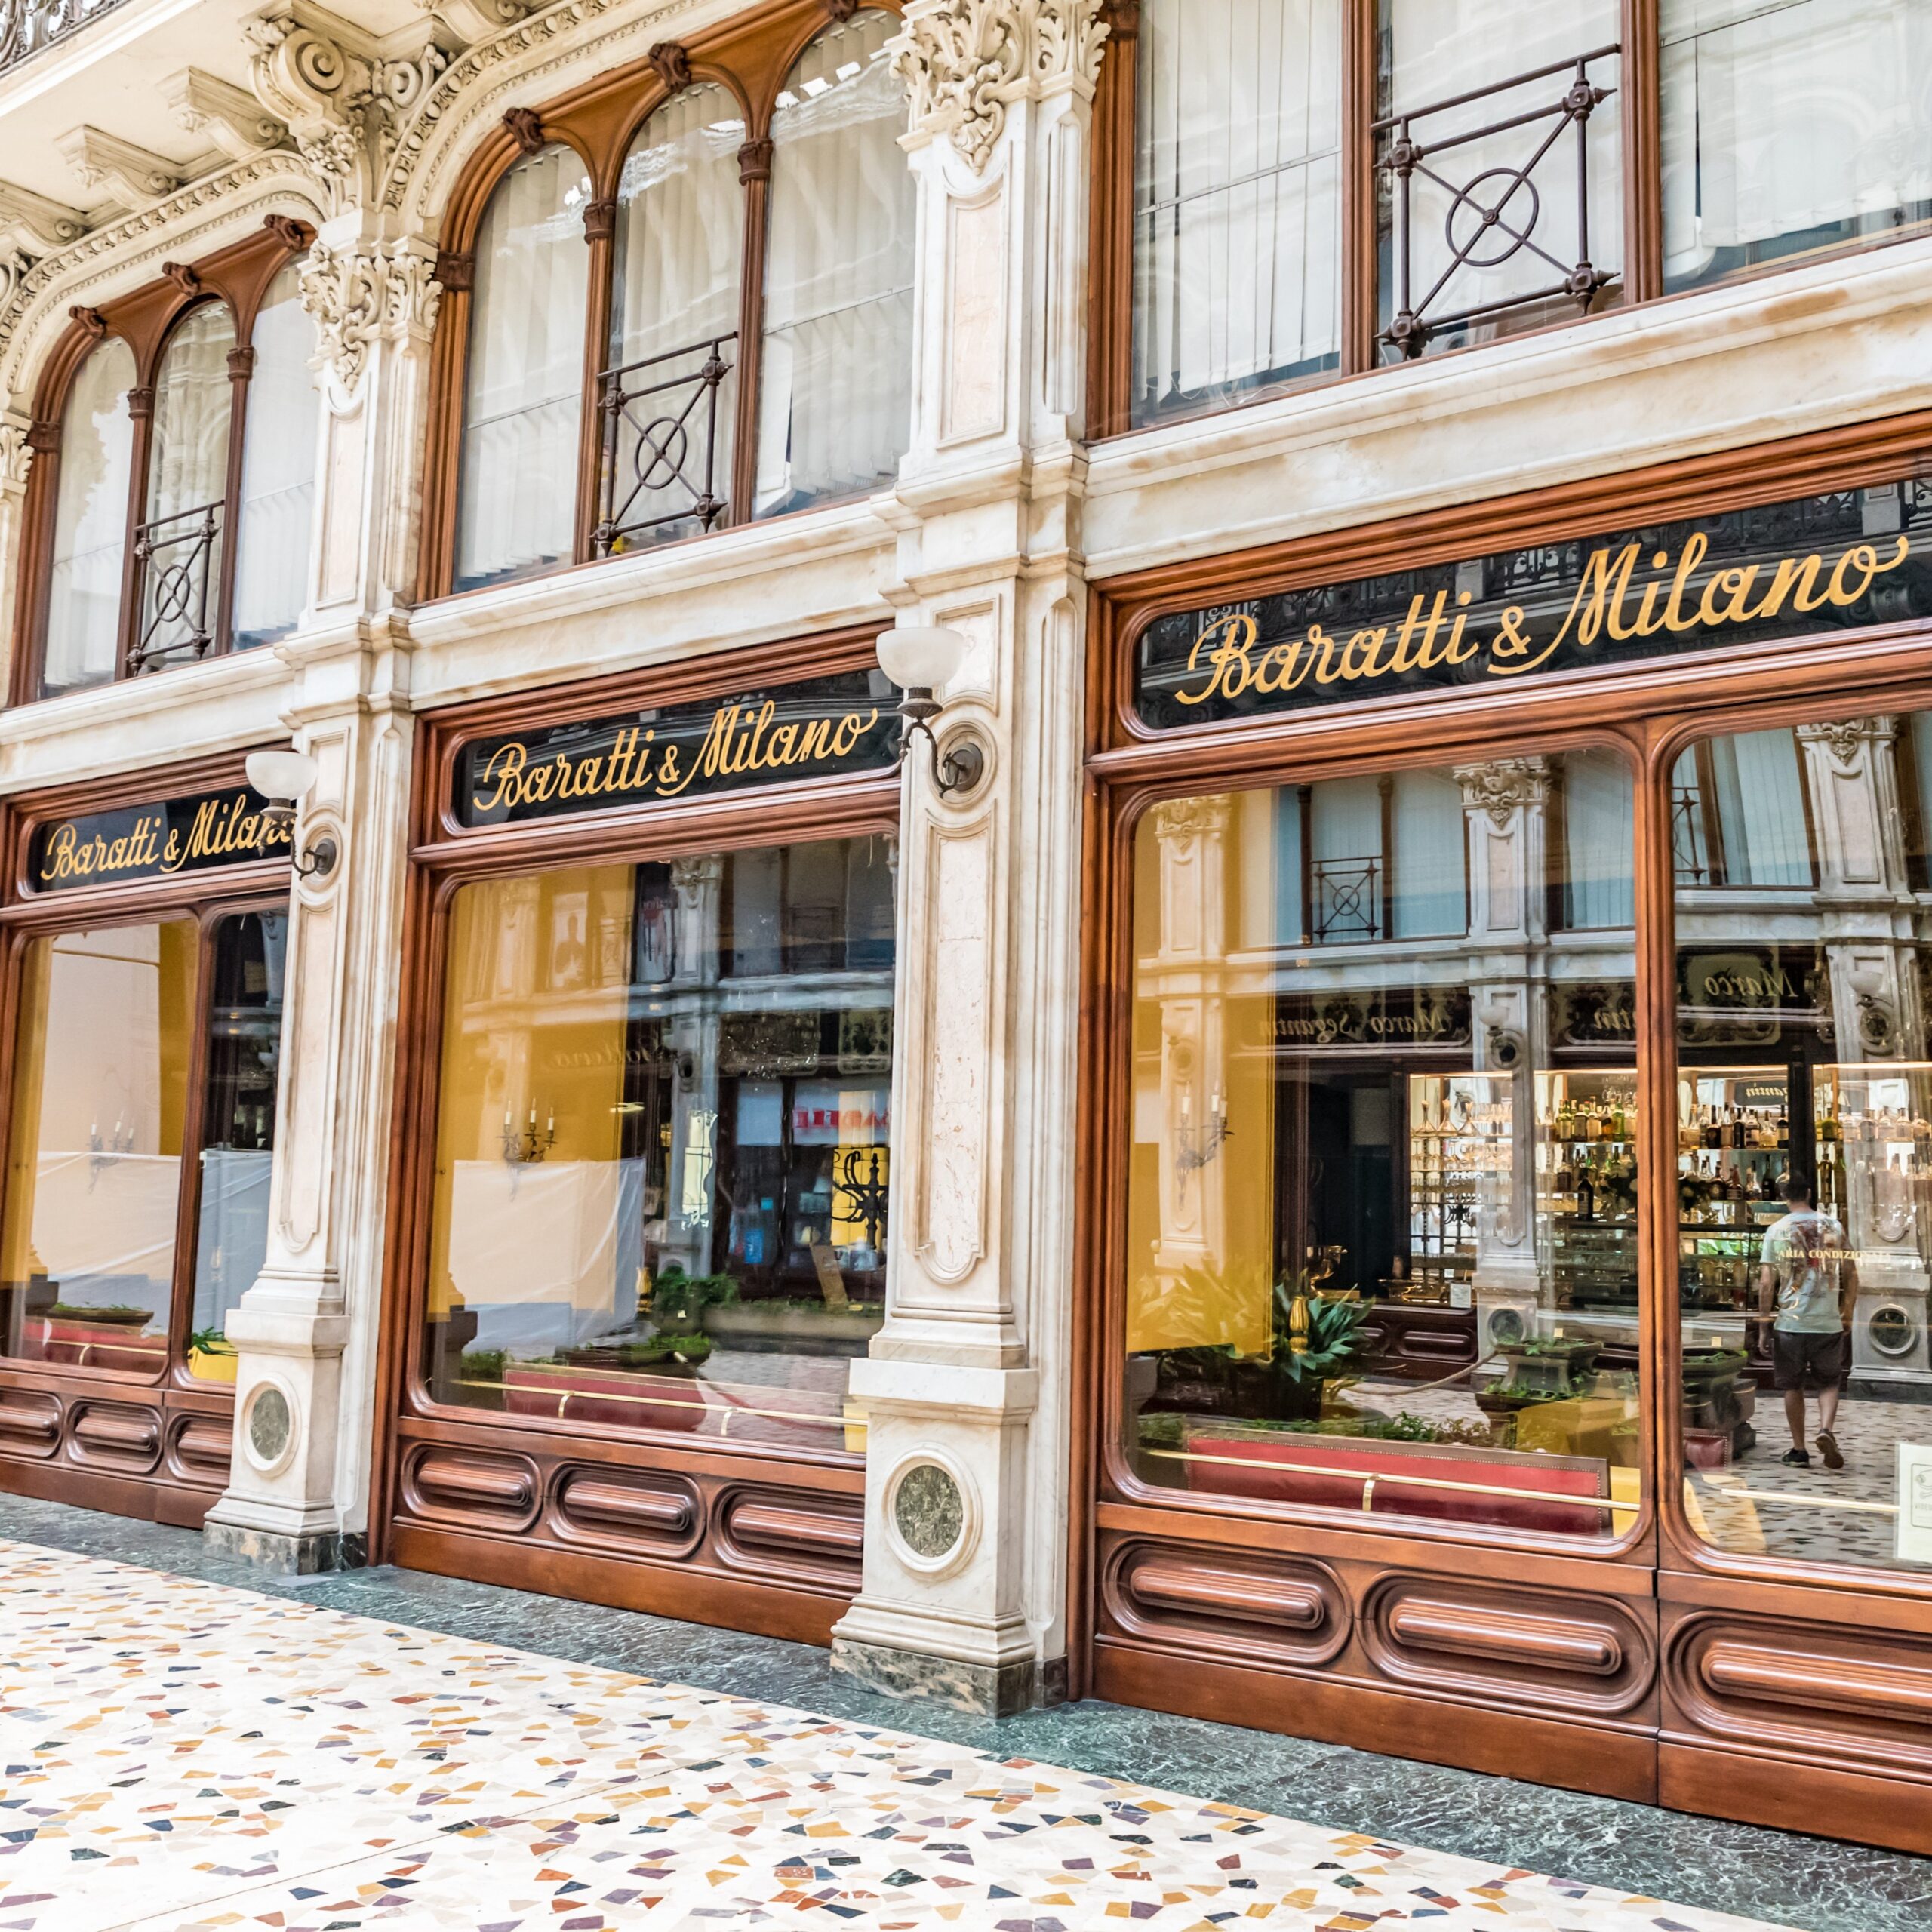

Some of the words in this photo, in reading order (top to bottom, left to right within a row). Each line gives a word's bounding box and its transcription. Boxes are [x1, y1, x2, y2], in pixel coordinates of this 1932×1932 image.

[1487, 531, 1909, 676] Milano
[1491, 607, 1531, 658] &
[1174, 589, 1479, 706] Baratti
[473, 727, 653, 811] Baratti
[655, 700, 878, 797] Milano
[659, 745, 679, 783] &
[40, 817, 160, 881] Baratti
[163, 828, 180, 862] &
[1778, 1249, 1805, 1259] ARIA
